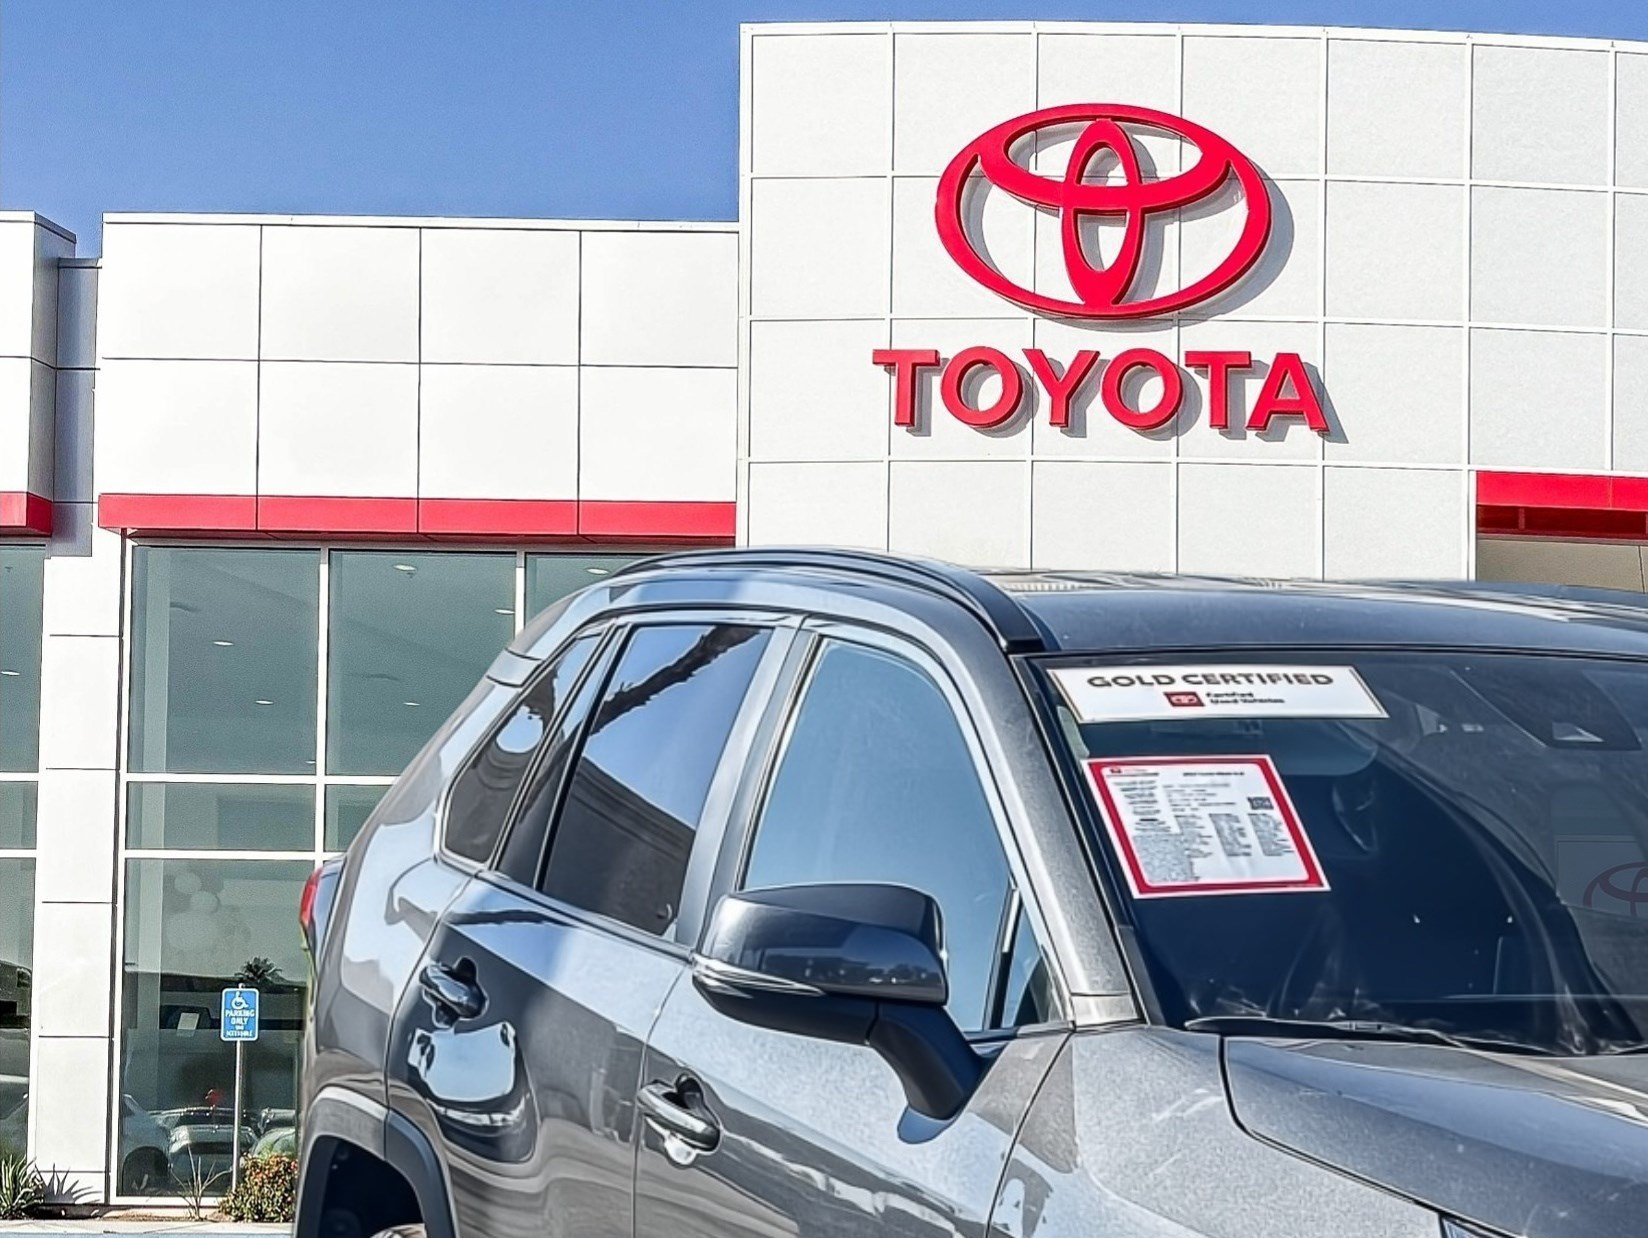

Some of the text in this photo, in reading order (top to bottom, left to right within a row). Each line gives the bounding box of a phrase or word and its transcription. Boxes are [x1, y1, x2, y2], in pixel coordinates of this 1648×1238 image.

[872, 346, 1330, 432] TOYOTA
[1086, 672, 1334, 688] GOLD CERTIFIED
[225, 1009, 255, 1017] PARKING
[230, 1016, 249, 1025] ONLY
